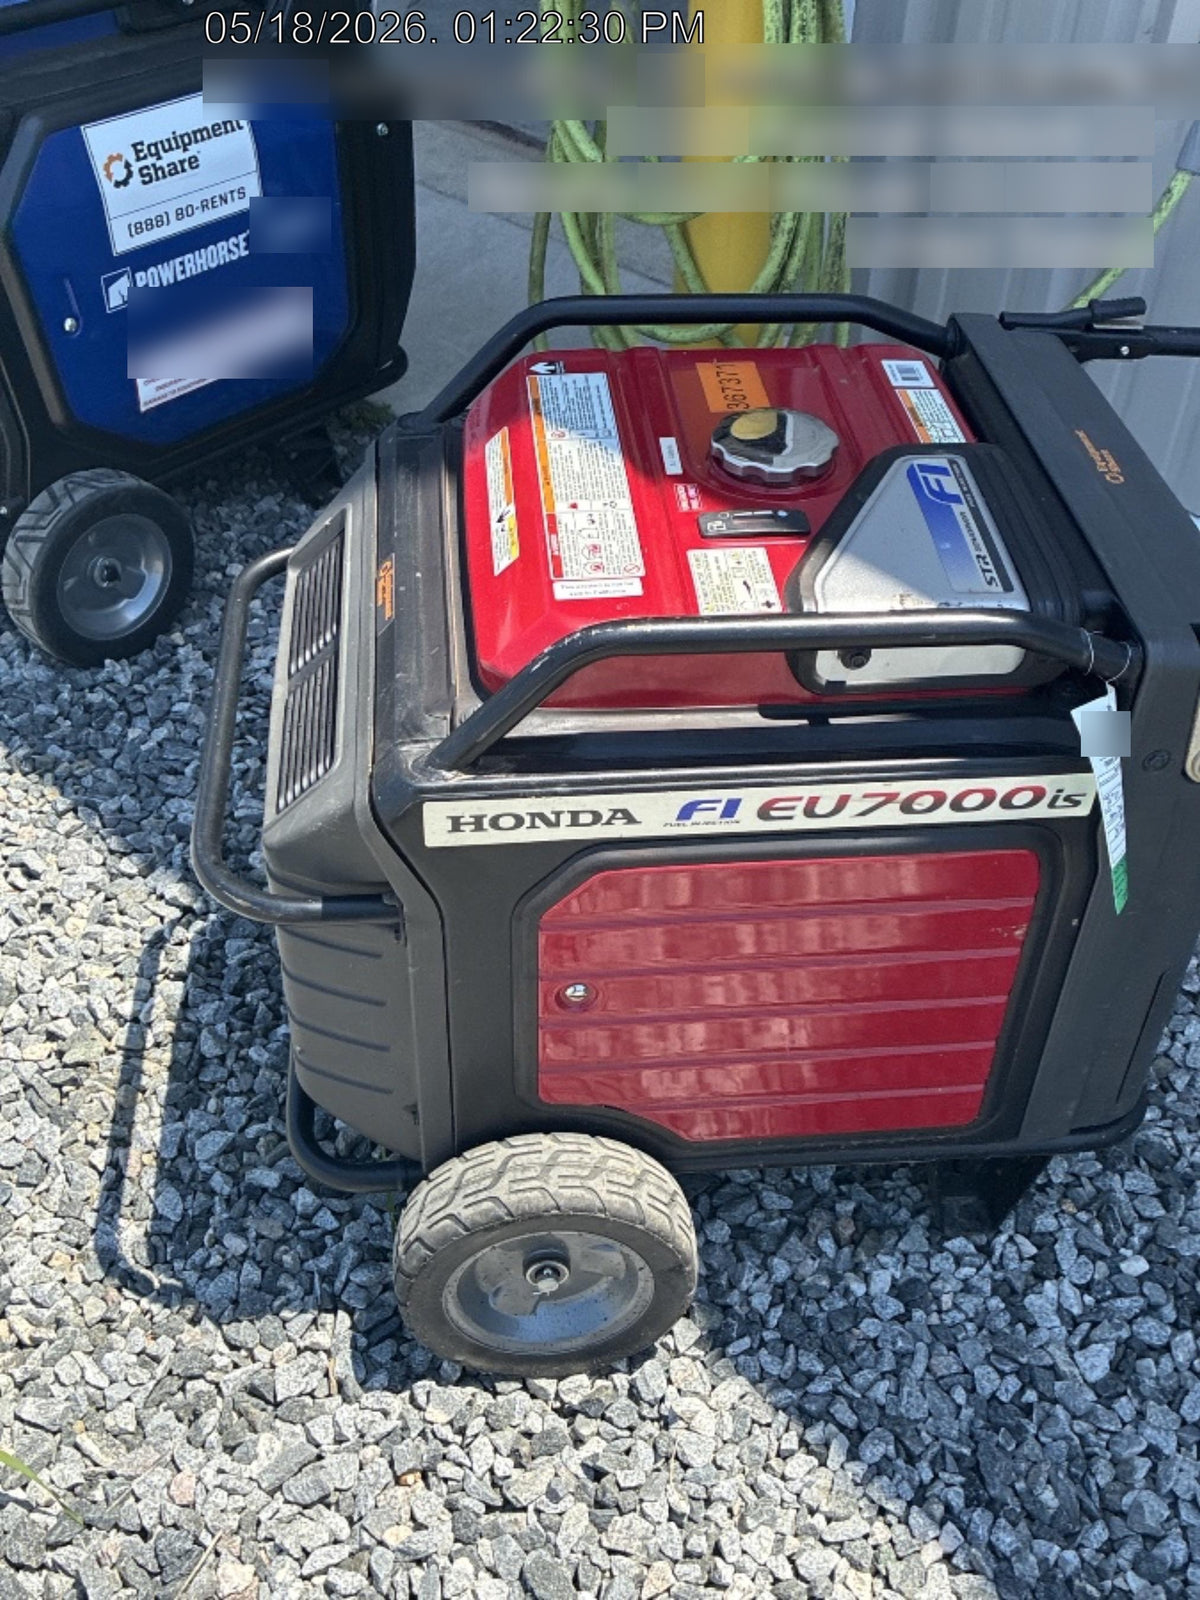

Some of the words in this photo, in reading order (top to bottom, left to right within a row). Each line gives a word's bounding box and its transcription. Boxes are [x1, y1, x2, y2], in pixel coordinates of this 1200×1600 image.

[131, 119, 244, 163] Equipment
[138, 155, 200, 186] Share
[127, 211, 171, 239] (888)
[175, 186, 246, 222] 80-RENTS
[134, 232, 249, 287] POWERHORSE
[446, 808, 642, 833] HONDA
[676, 798, 741, 821] FI
